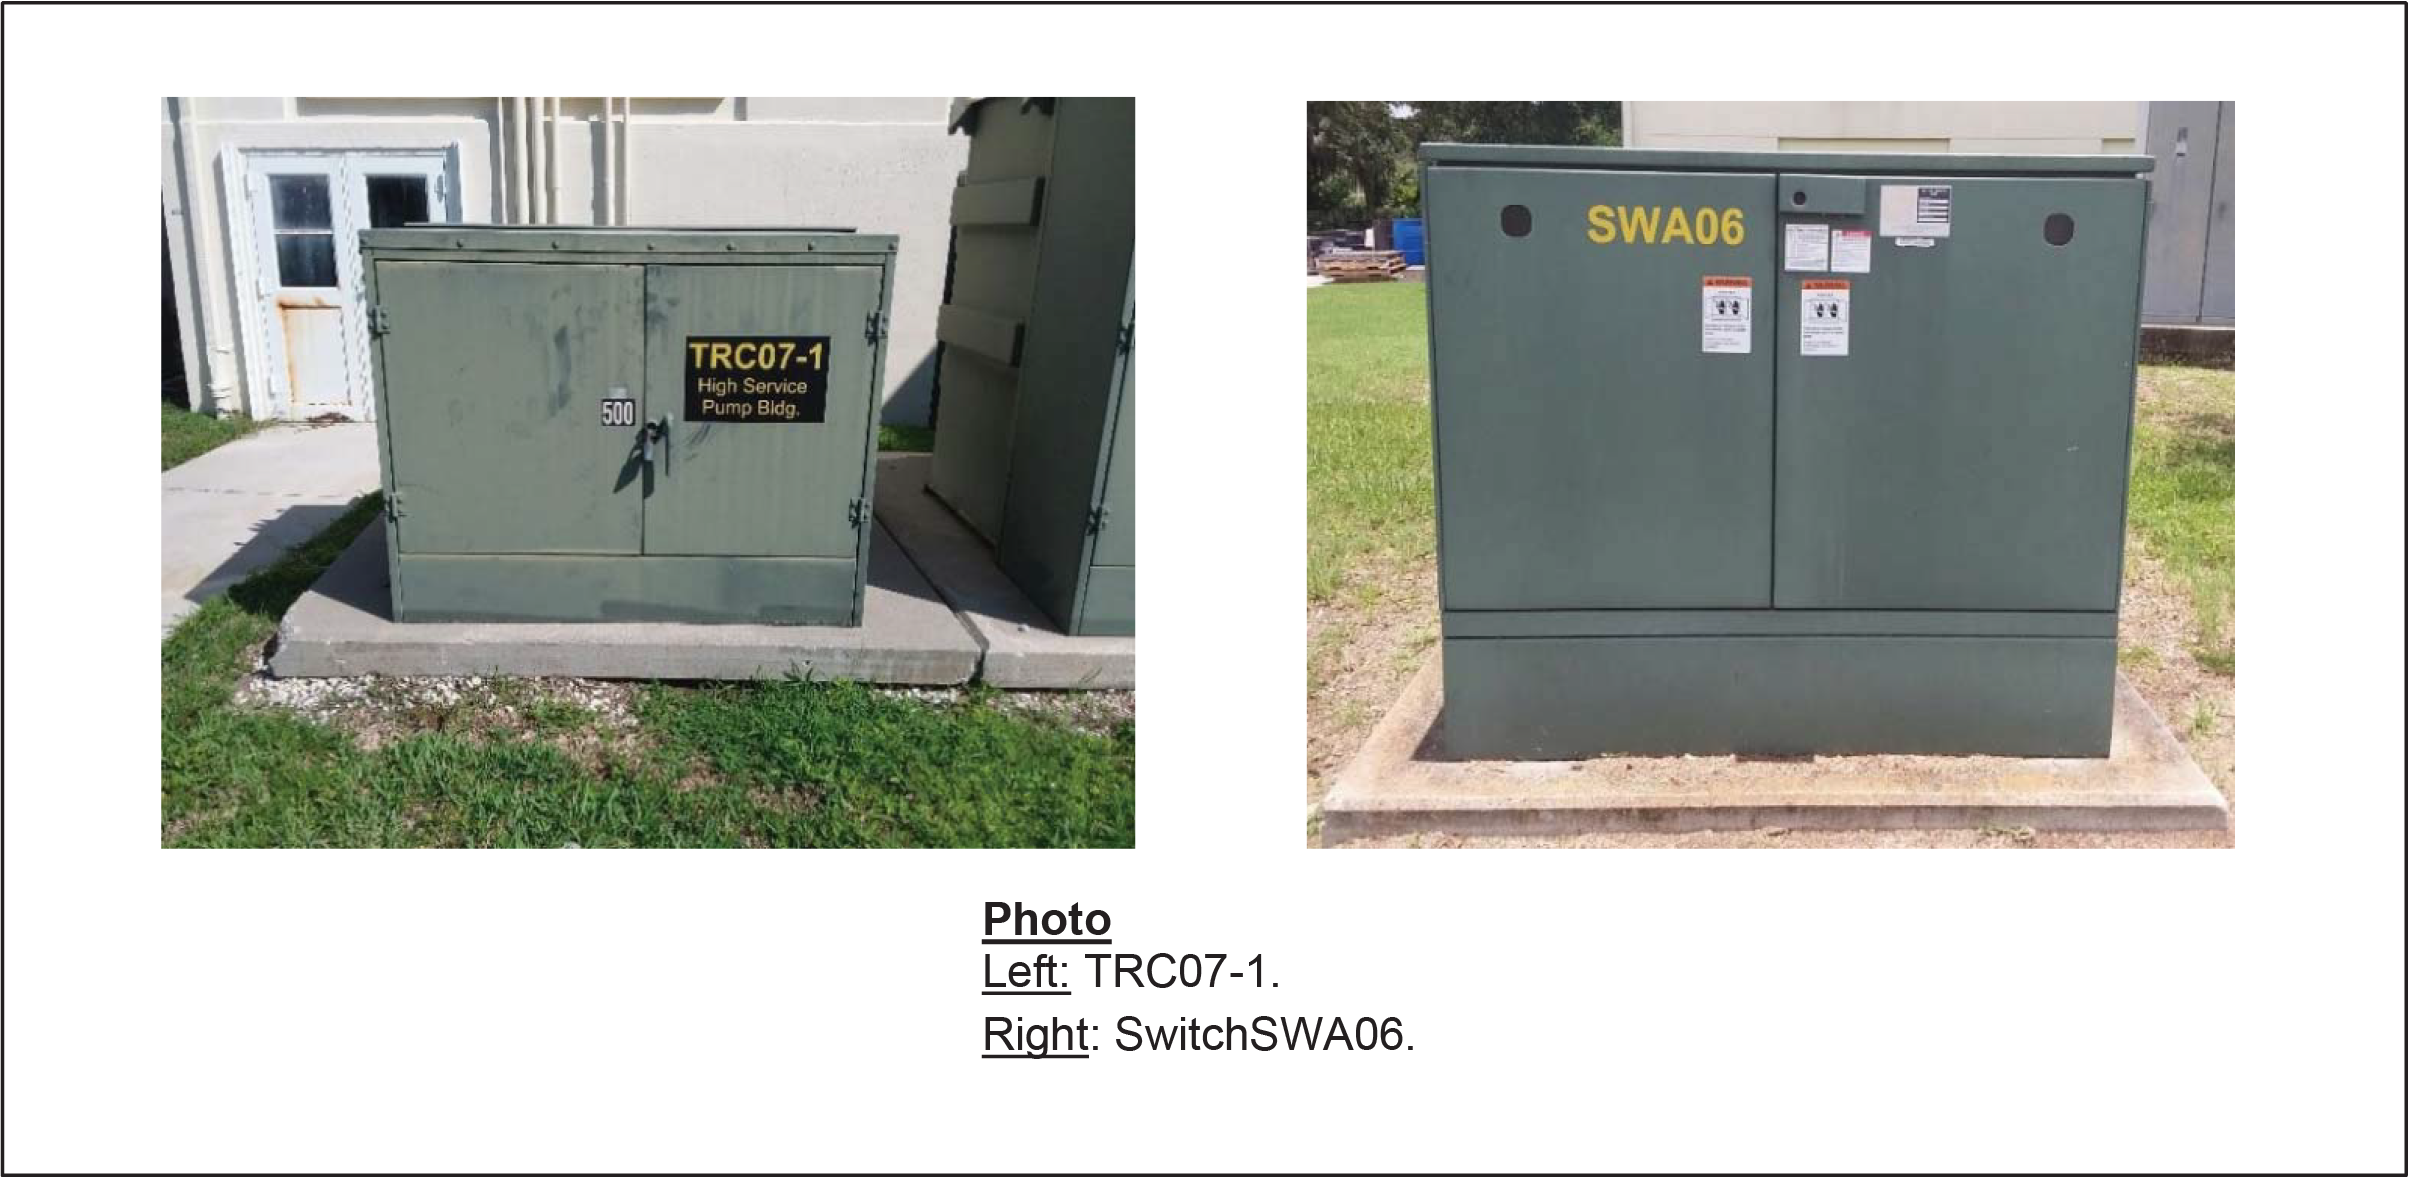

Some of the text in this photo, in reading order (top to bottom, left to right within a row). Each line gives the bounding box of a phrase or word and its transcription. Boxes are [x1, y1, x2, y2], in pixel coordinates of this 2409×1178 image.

[1586, 204, 1745, 246] SWA06
[689, 342, 823, 370] TRC07-1
[698, 377, 808, 396] High Service
[602, 401, 634, 426] 500
[702, 399, 801, 418] Pump Bldg.
